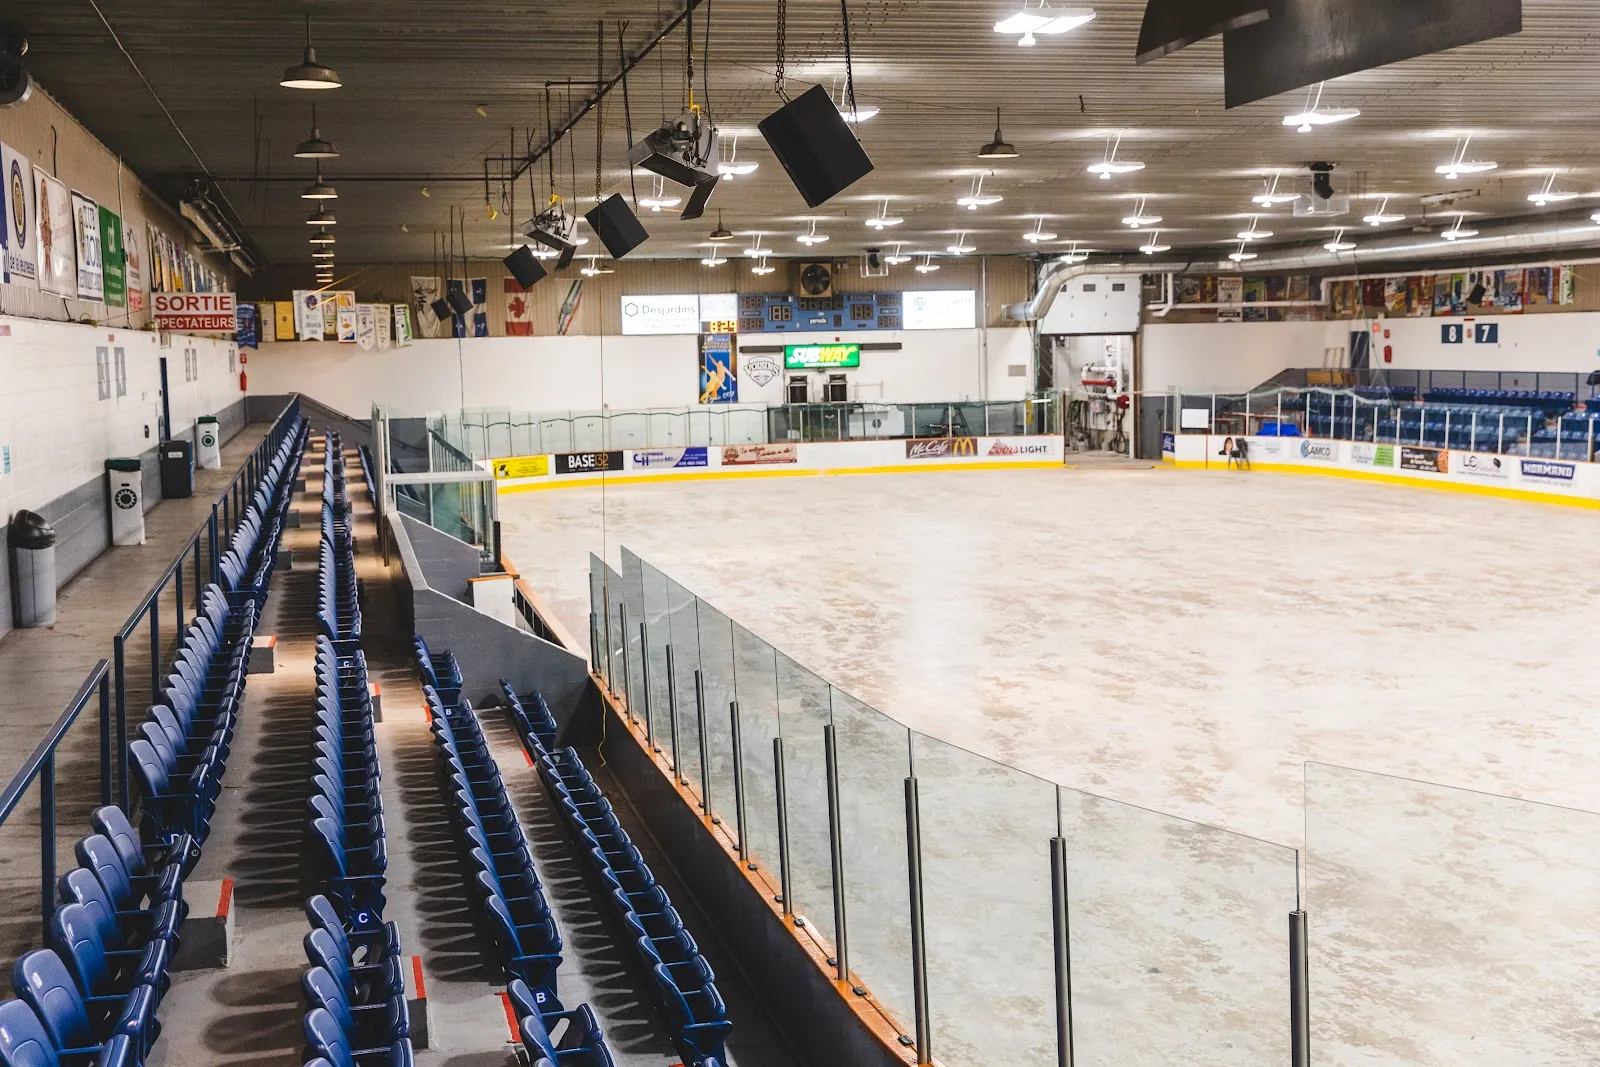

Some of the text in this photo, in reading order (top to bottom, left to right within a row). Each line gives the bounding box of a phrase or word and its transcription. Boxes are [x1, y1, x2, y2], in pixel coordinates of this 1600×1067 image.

[155, 296, 231, 311] SORTIE
[642, 304, 695, 316] Desjardins
[710, 320, 737, 333] 8:29
[1448, 325, 1490, 342] 8 7
[787, 345, 857, 364] SUBWAY
[743, 361, 780, 377] VOISINS
[1020, 445, 1047, 454] LIGHT
[1304, 442, 1331, 457] KAMCO
[1523, 463, 1573, 478] NORMAND
[445, 708, 452, 716] B
[358, 912, 369, 923] C
[536, 992, 546, 1004] B
